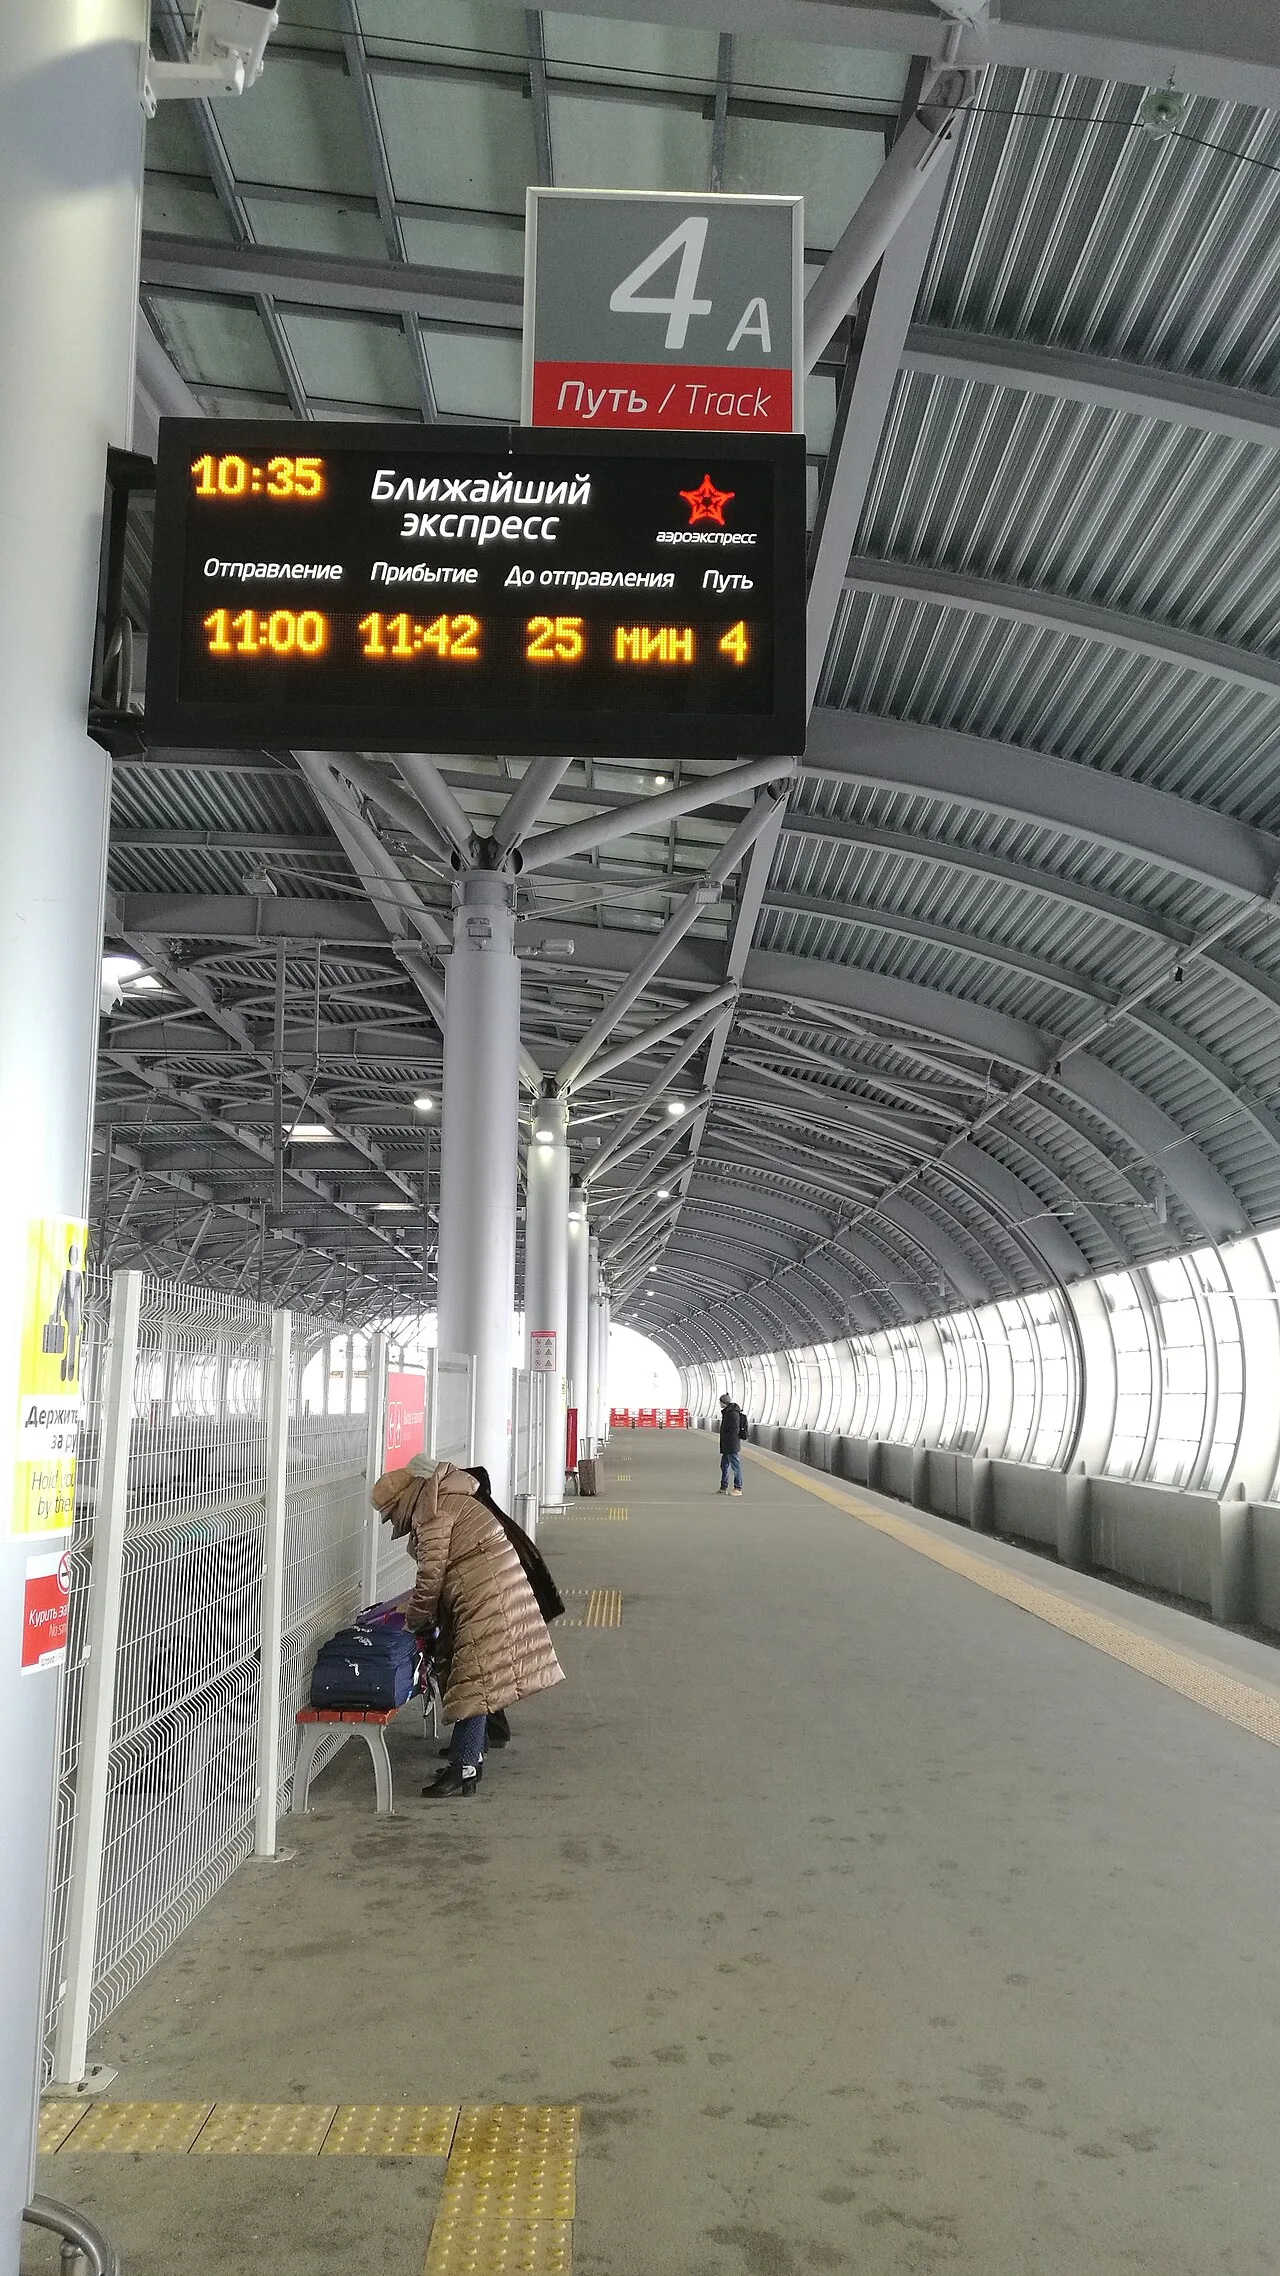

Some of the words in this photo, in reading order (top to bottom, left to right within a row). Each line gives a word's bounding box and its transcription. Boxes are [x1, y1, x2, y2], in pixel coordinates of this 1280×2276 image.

[610, 216, 713, 350] 4
[557, 380, 648, 419] Путь
[685, 384, 772, 418] Track
[191, 454, 324, 497] 10:35
[371, 469, 592, 505] Ближайший
[400, 512, 560, 545] экспресс
[656, 530, 758, 546] аэроэкспресс
[203, 557, 344, 582] Отправление
[370, 561, 480, 586] Прибытие
[503, 565, 536, 588] До
[539, 569, 676, 591] отправления
[702, 569, 755, 594] Путь
[204, 608, 325, 652] 11:00
[358, 612, 480, 656] 11:42
[526, 615, 585, 659] 25
[719, 620, 748, 663] 4
[50, 1433, 64, 1450] за
[32, 1469, 59, 1491] Hold
[37, 1496, 52, 1520] by
[28, 1607, 58, 1628] Курить
